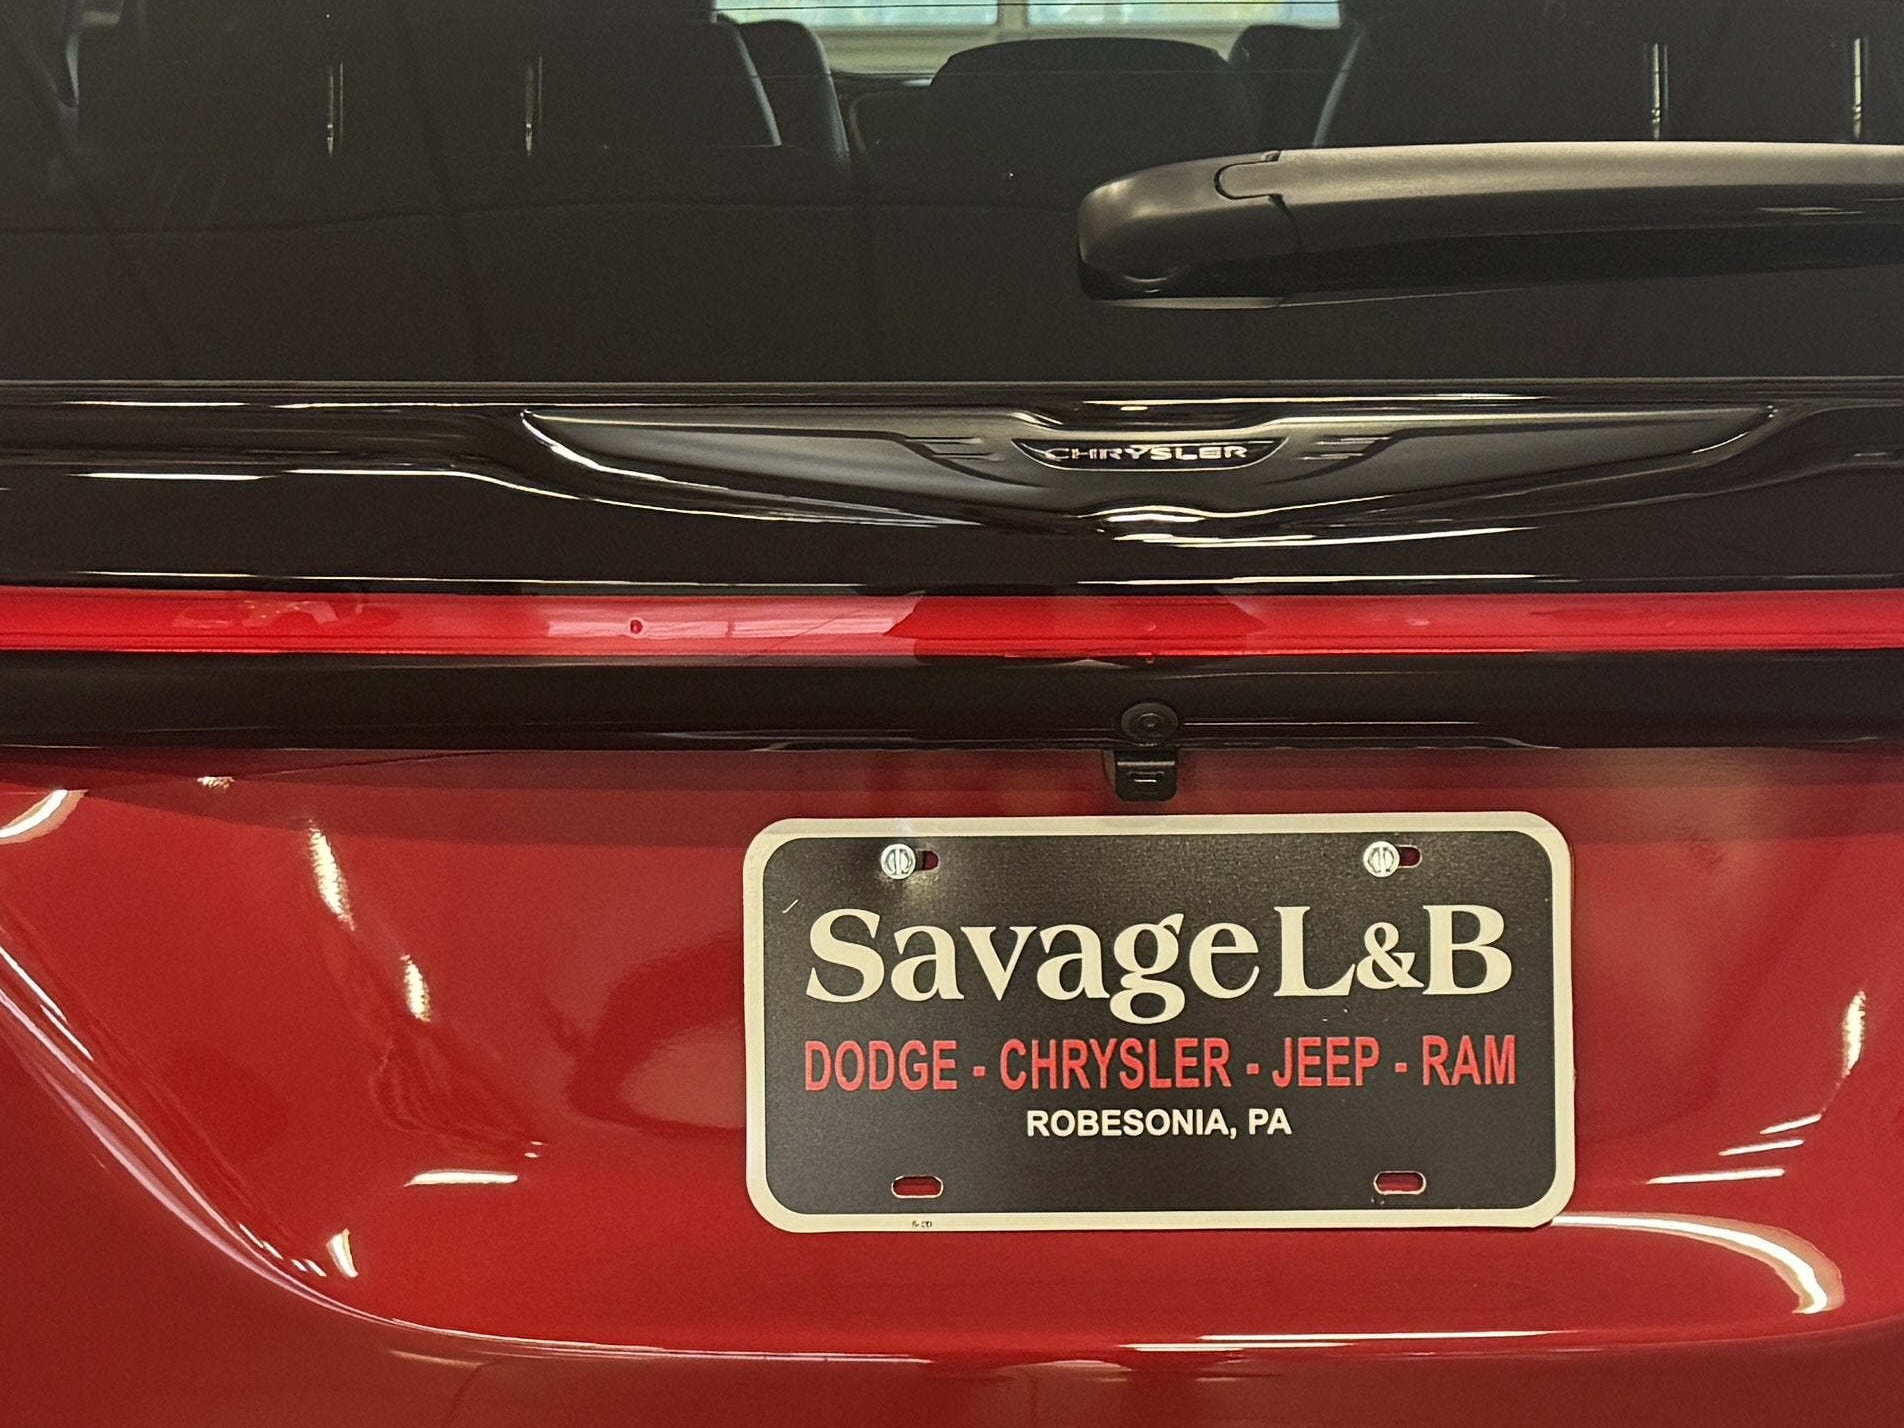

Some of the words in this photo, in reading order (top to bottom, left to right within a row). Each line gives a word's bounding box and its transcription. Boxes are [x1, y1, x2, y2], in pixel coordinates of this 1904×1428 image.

[1042, 444, 1248, 462] CHRYSLER
[805, 1041, 958, 1093] DODGE
[1000, 1038, 1232, 1092] CHRYSLER
[1272, 1036, 1381, 1089] JEEP
[1423, 1035, 1517, 1086] RAM
[1026, 1108, 1237, 1140] ROBESONIA,
[1248, 1107, 1293, 1135] PA
